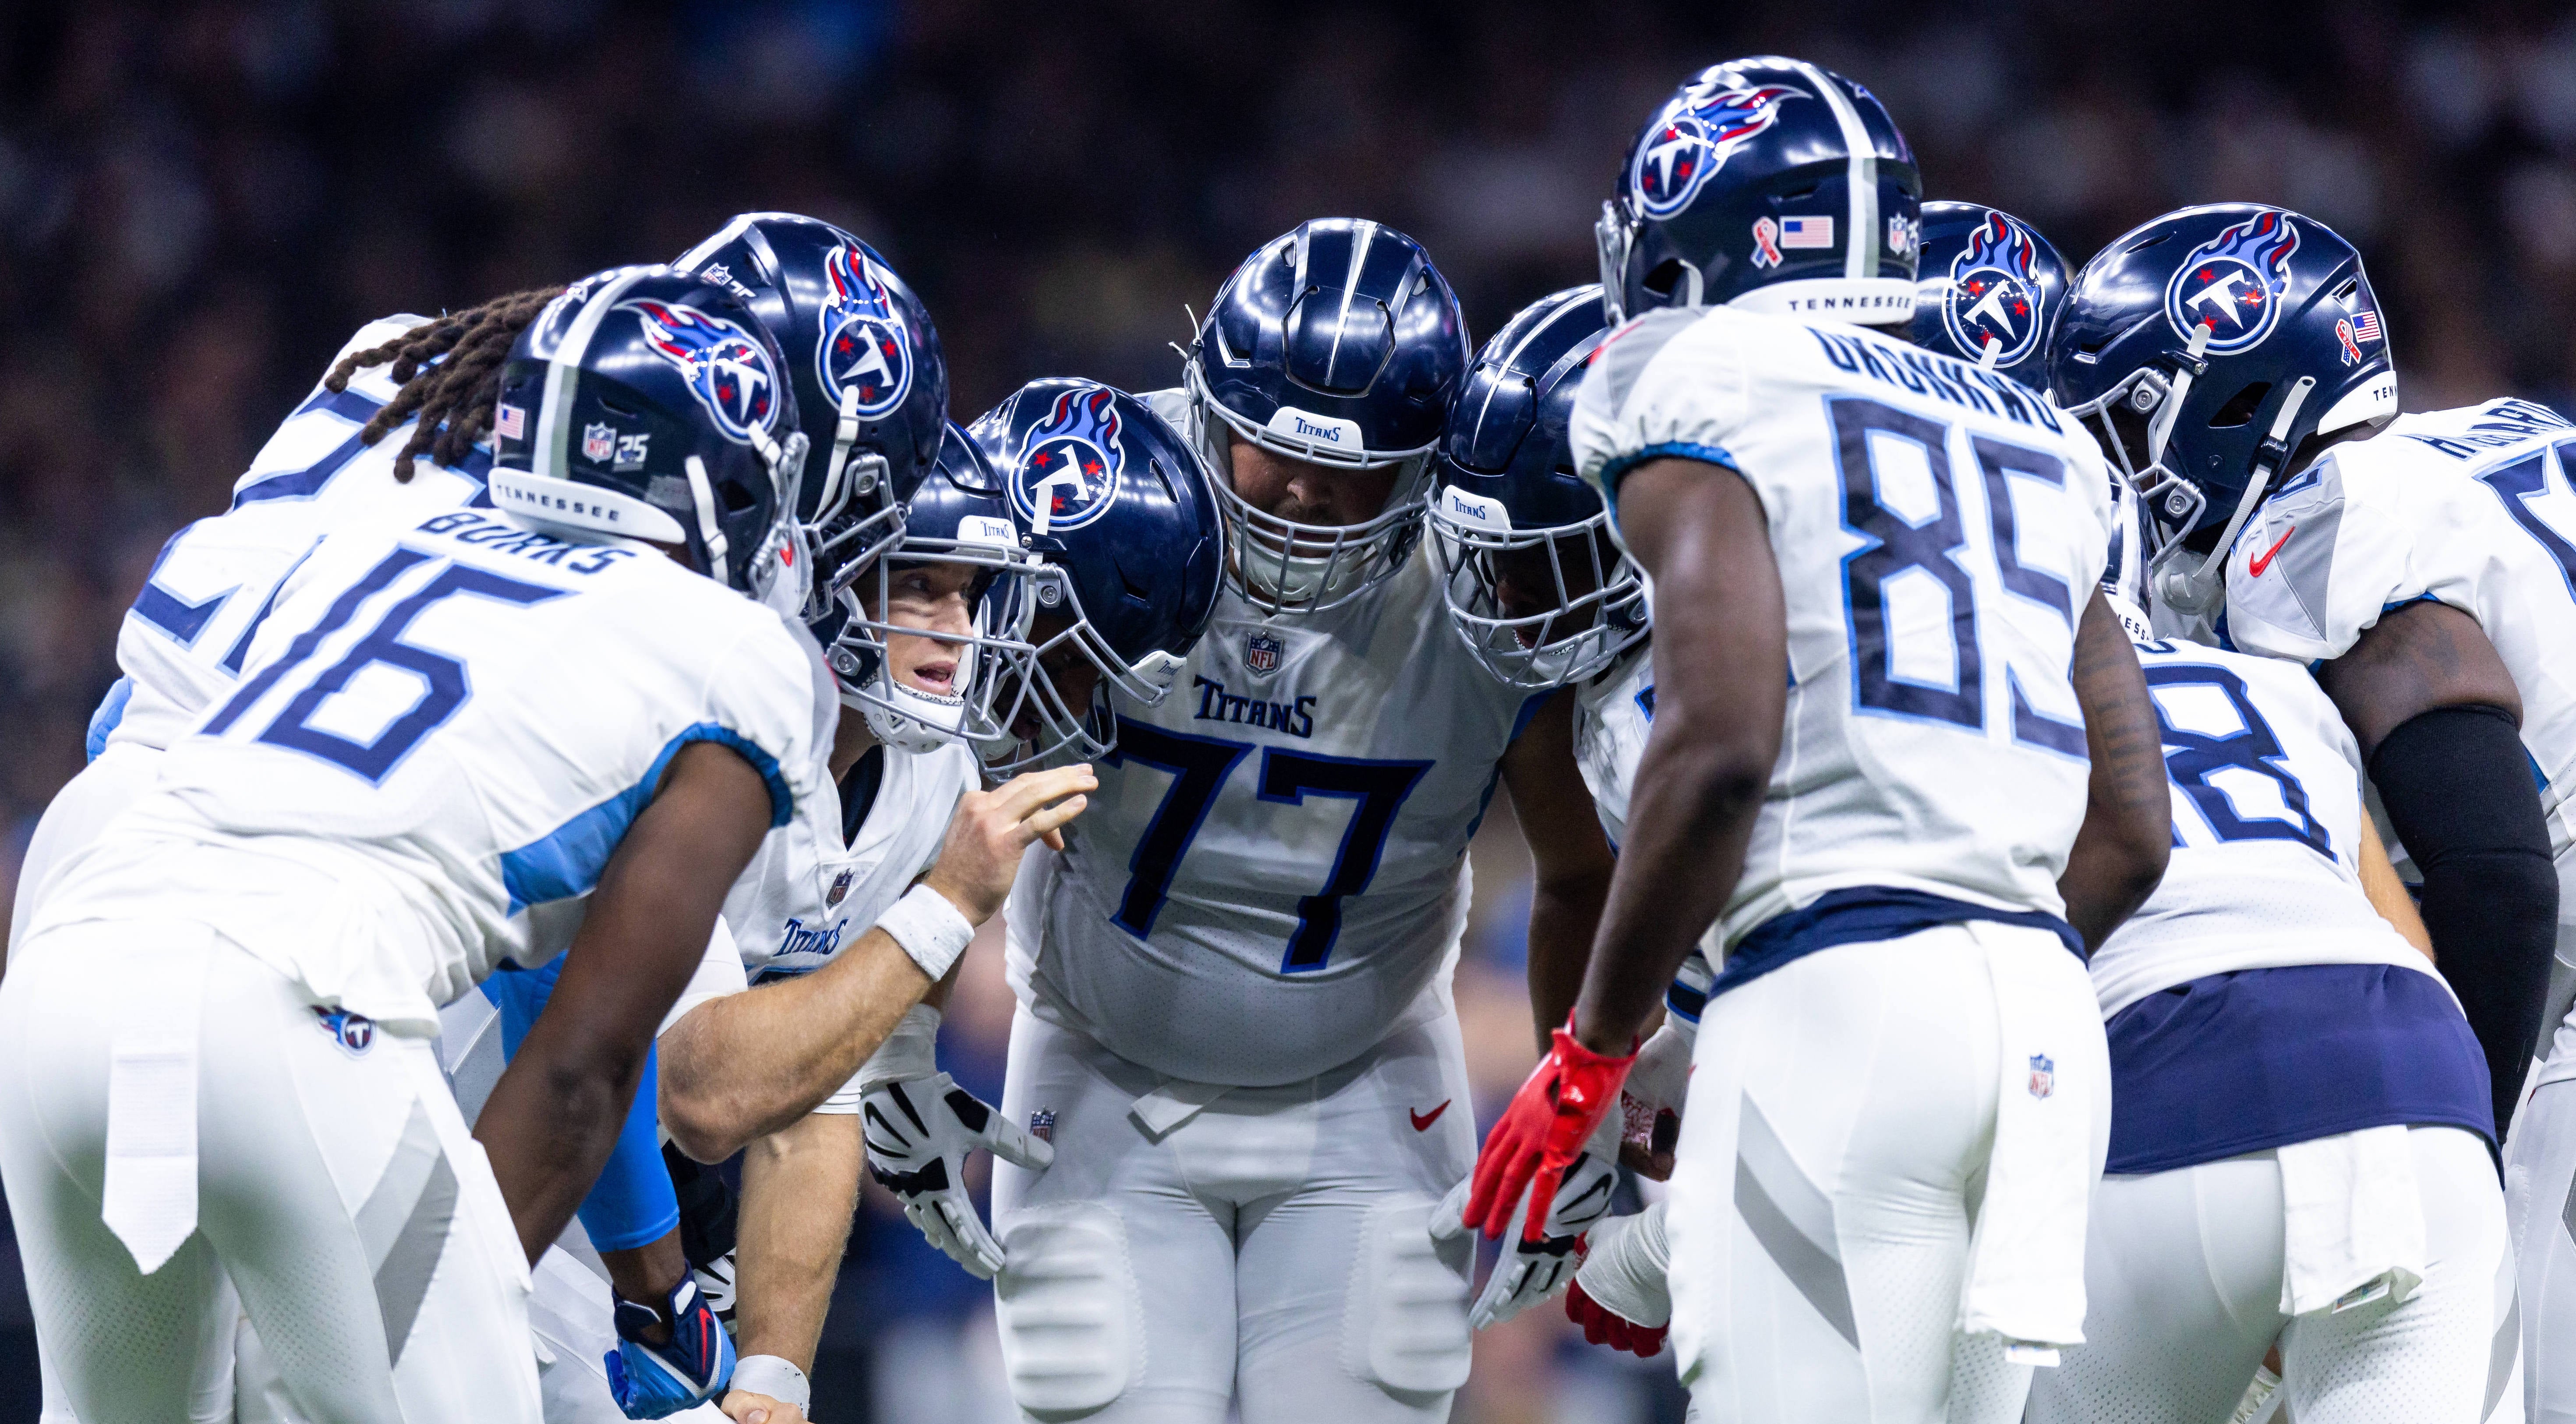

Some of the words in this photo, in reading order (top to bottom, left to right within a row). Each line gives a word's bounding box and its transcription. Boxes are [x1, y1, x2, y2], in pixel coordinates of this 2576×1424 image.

[1788, 296, 1912, 312] TENNESSEE
[2343, 336, 2353, 350] 9/11
[1295, 416, 1341, 442] TITANS
[496, 484, 620, 521] TENNESSEE
[1453, 495, 1485, 520] TITANS
[980, 521, 1009, 539] TITANS
[1821, 393, 2092, 766] 85
[194, 542, 583, 789] 16
[1248, 648, 1274, 669] NFL
[1194, 675, 1317, 739] TITANS
[2142, 662, 2339, 865] 8
[1082, 706, 1436, 974] 77
[772, 917, 850, 957] TITANS
